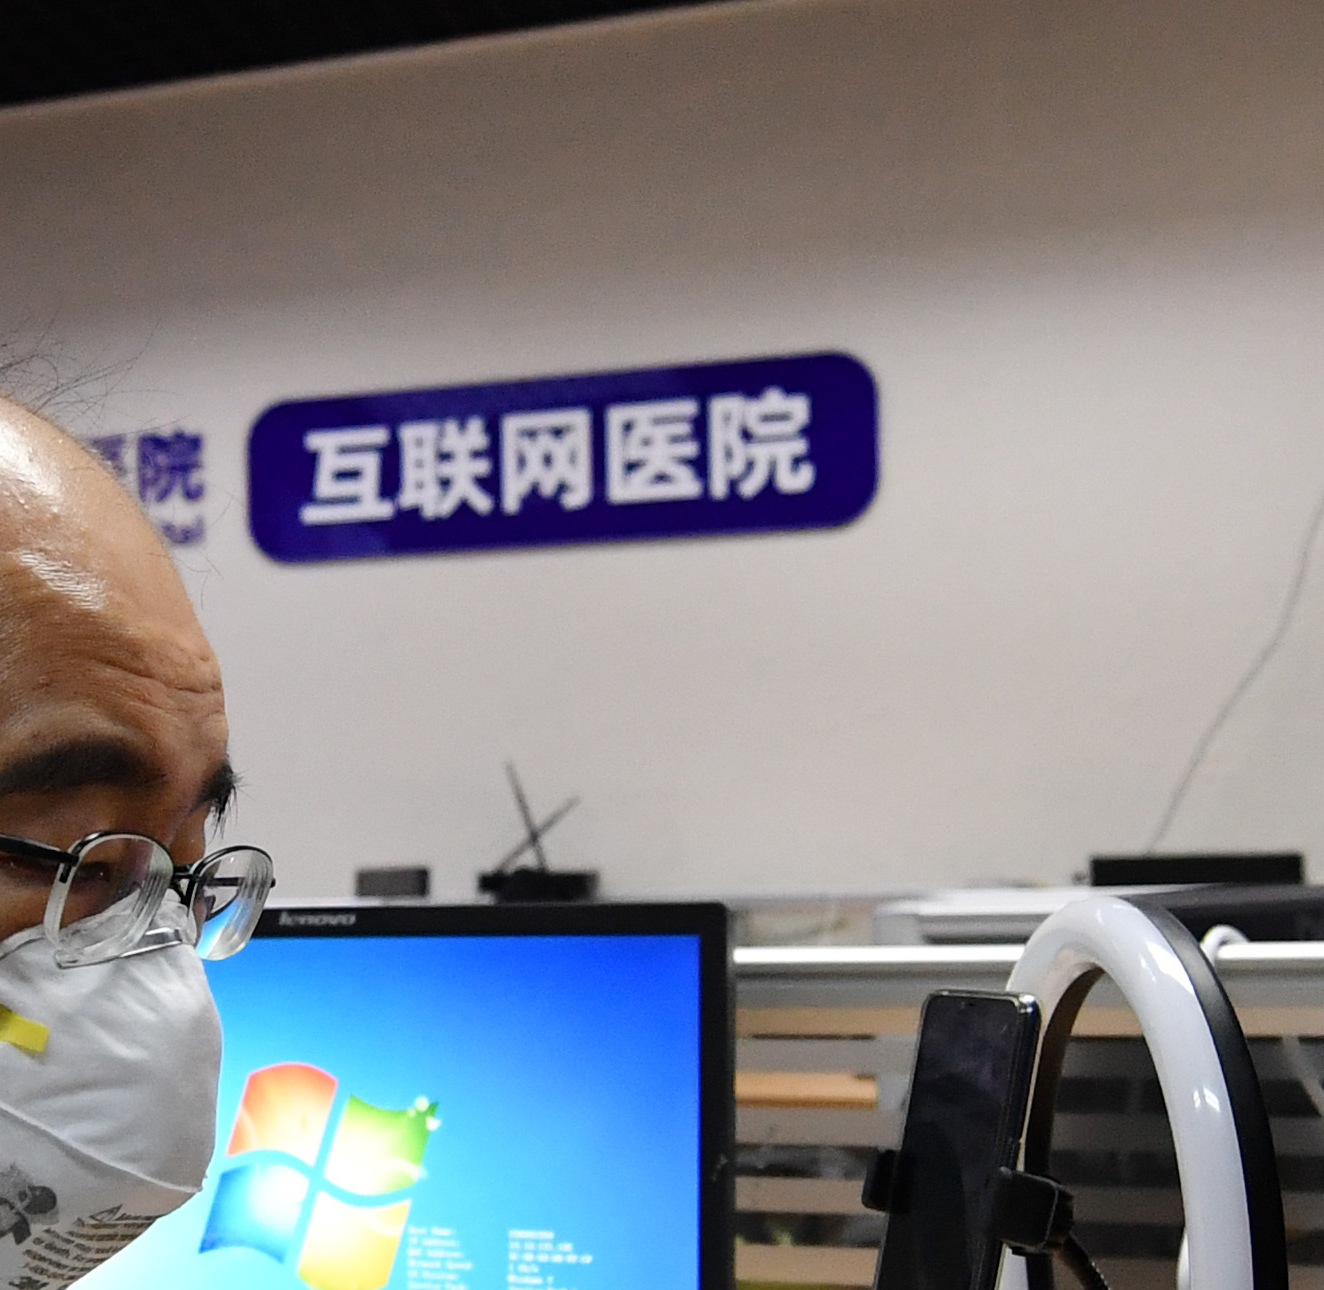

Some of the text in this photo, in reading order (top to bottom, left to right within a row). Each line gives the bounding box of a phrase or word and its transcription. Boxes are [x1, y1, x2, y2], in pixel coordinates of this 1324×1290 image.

[298, 386, 817, 526] 互联网医院
